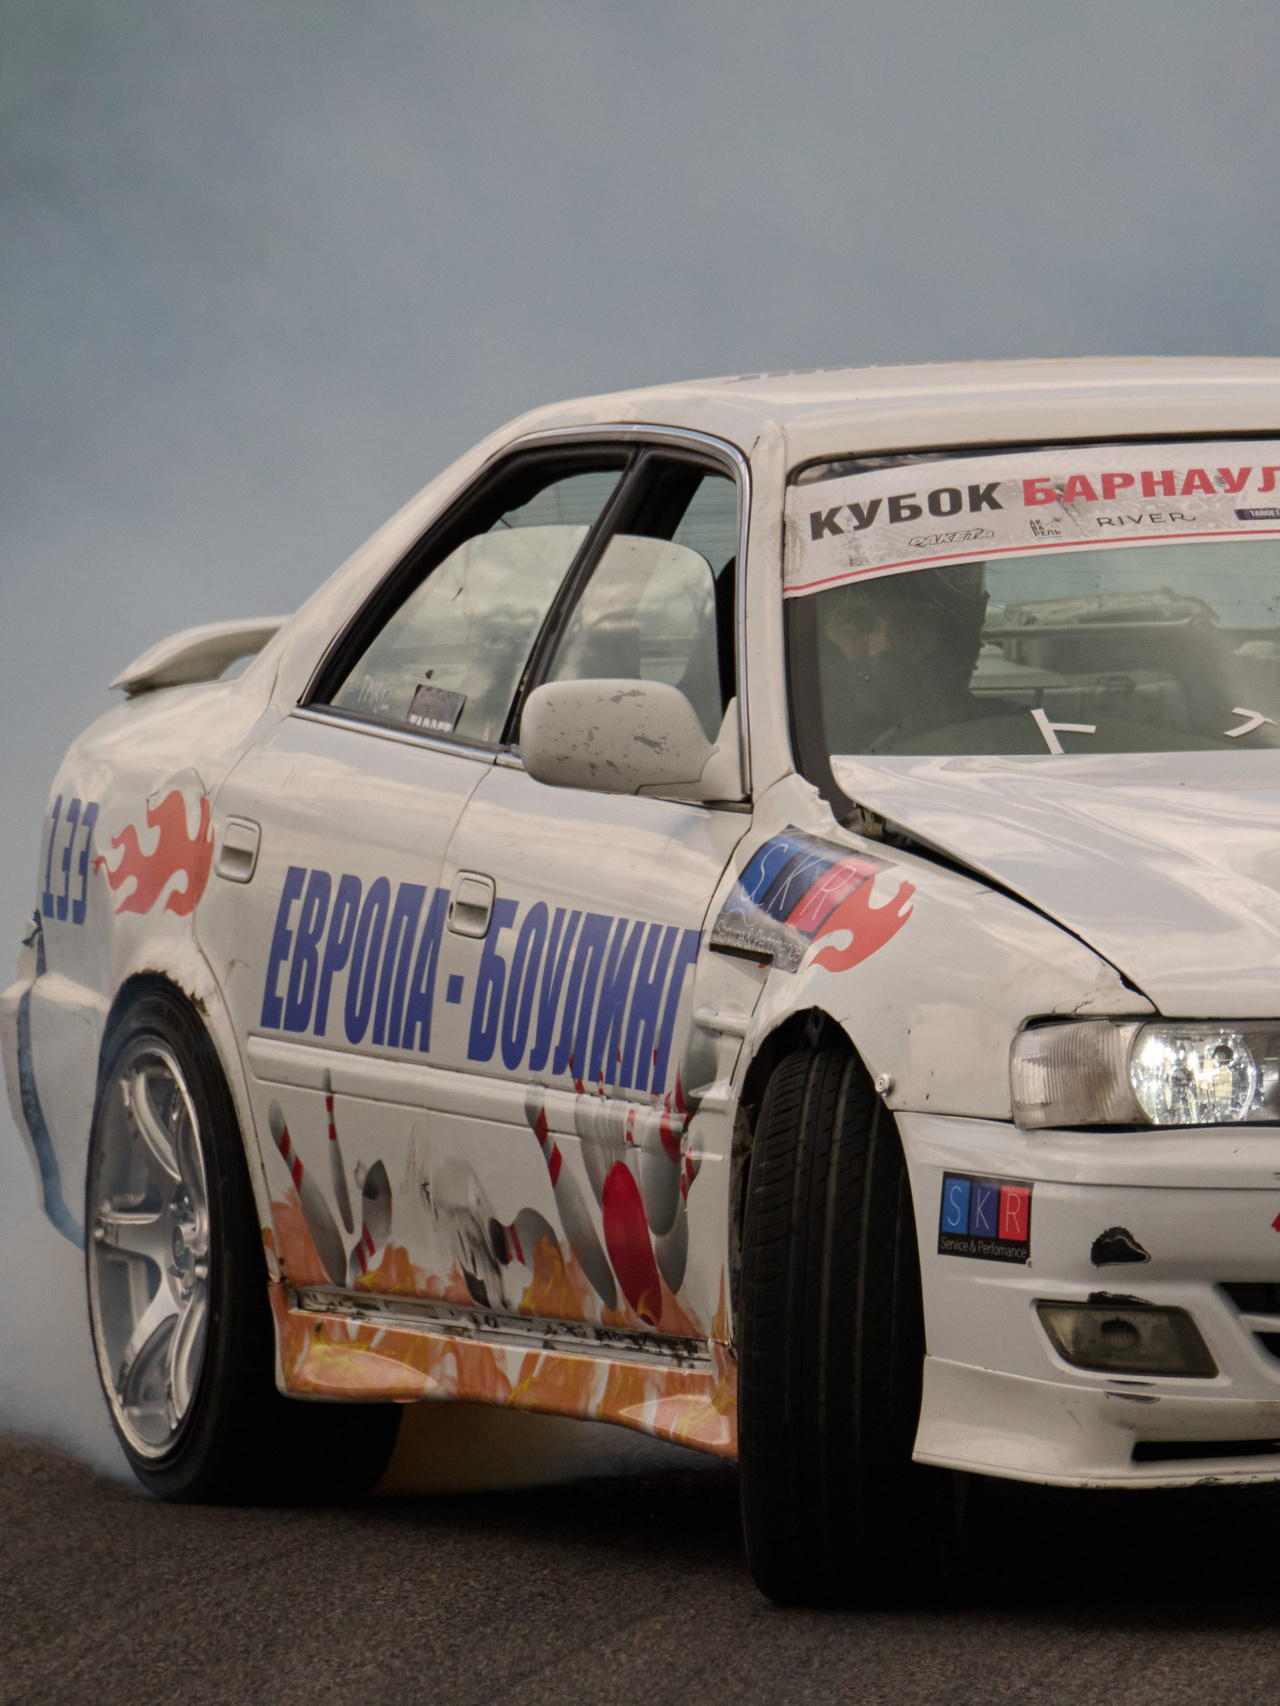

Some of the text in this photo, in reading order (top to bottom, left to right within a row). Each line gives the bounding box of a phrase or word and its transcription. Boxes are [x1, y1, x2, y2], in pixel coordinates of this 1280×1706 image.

[809, 481, 1004, 542] КУБОК
[1096, 512, 1197, 528] RIVER
[908, 528, 995, 548] РАКЕТА
[947, 1185, 1021, 1234] SKR
[940, 1236, 969, 1252] Service
